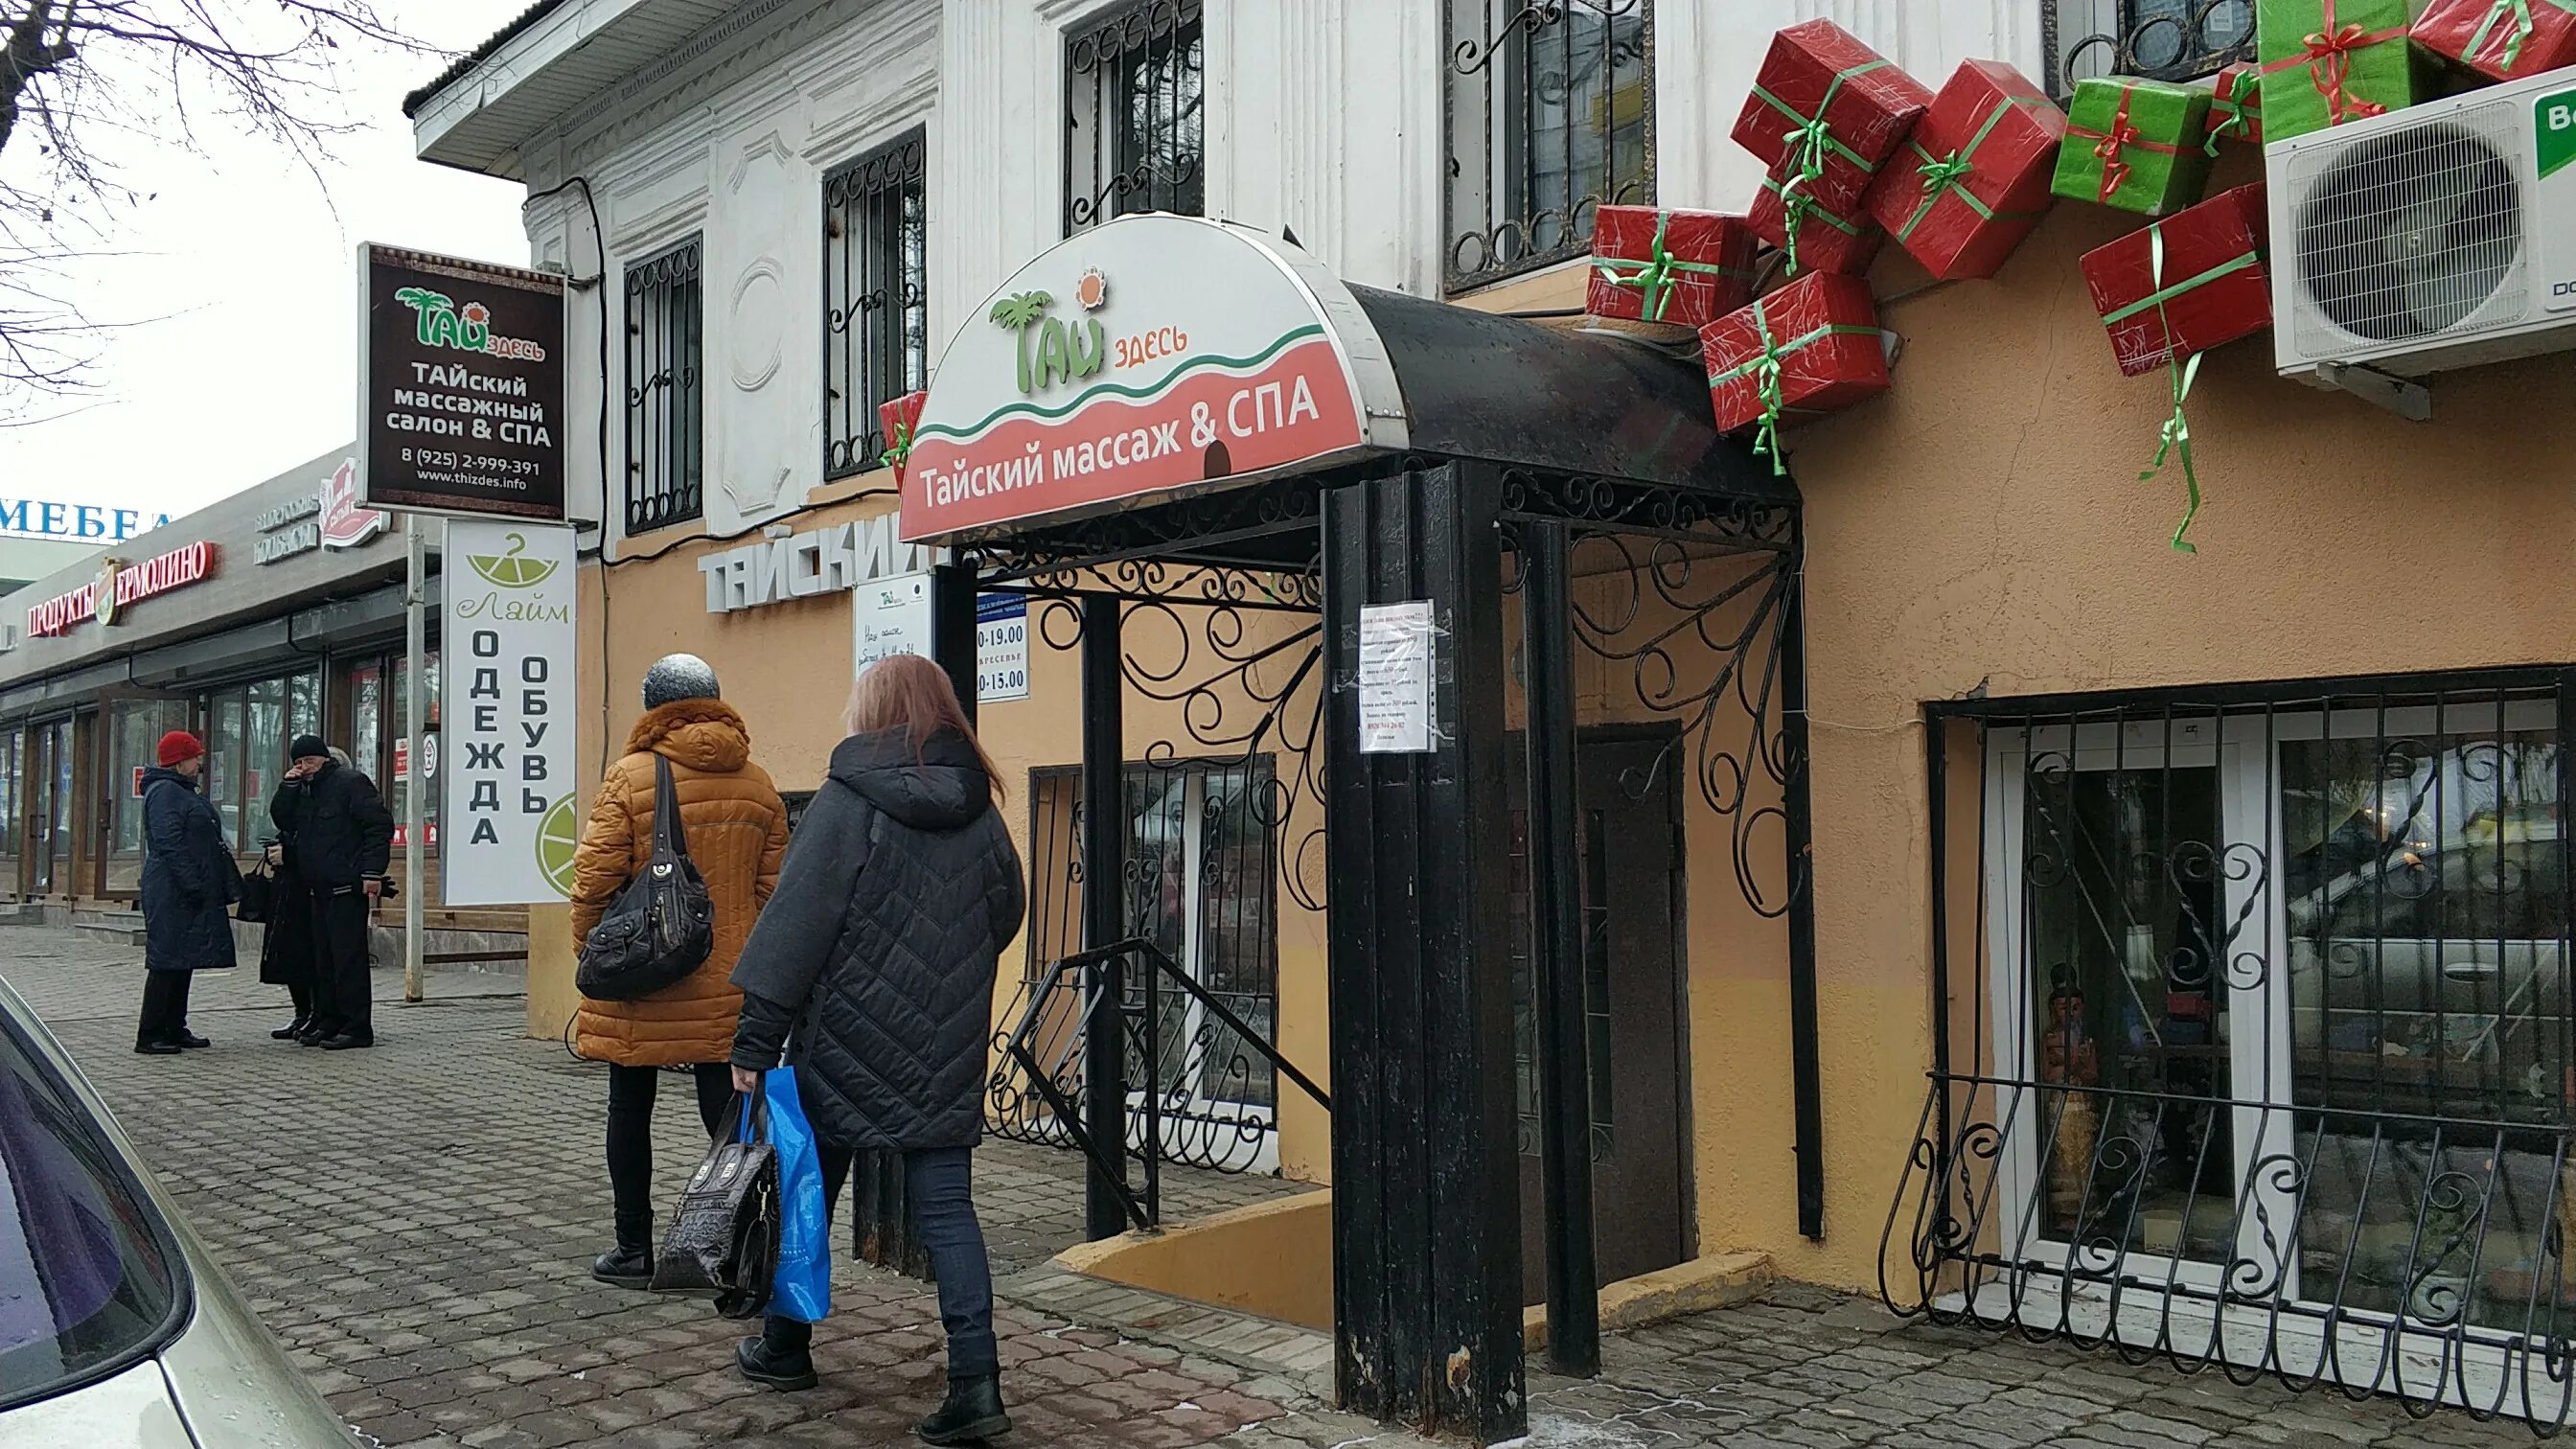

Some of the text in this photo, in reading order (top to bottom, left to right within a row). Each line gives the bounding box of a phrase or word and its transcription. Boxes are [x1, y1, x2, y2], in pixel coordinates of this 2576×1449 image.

[395, 288, 490, 353] ТАЙ
[989, 266, 1107, 394] ТАЙ
[386, 413, 551, 448] салон & СПА
[394, 388, 543, 423] массажный
[402, 448, 540, 475] 8 (925) 2-999-391
[920, 375, 1320, 508] Тайский массаж & СПА
[417, 470, 527, 490] www.thizdes.info
[28, 540, 209, 638] ПРОДУКТЫ ЕРМОЛИНО
[456, 592, 569, 624] Лайм
[465, 630, 505, 845] ОДЕЖДА
[520, 656, 549, 815] ОБУВЬ
